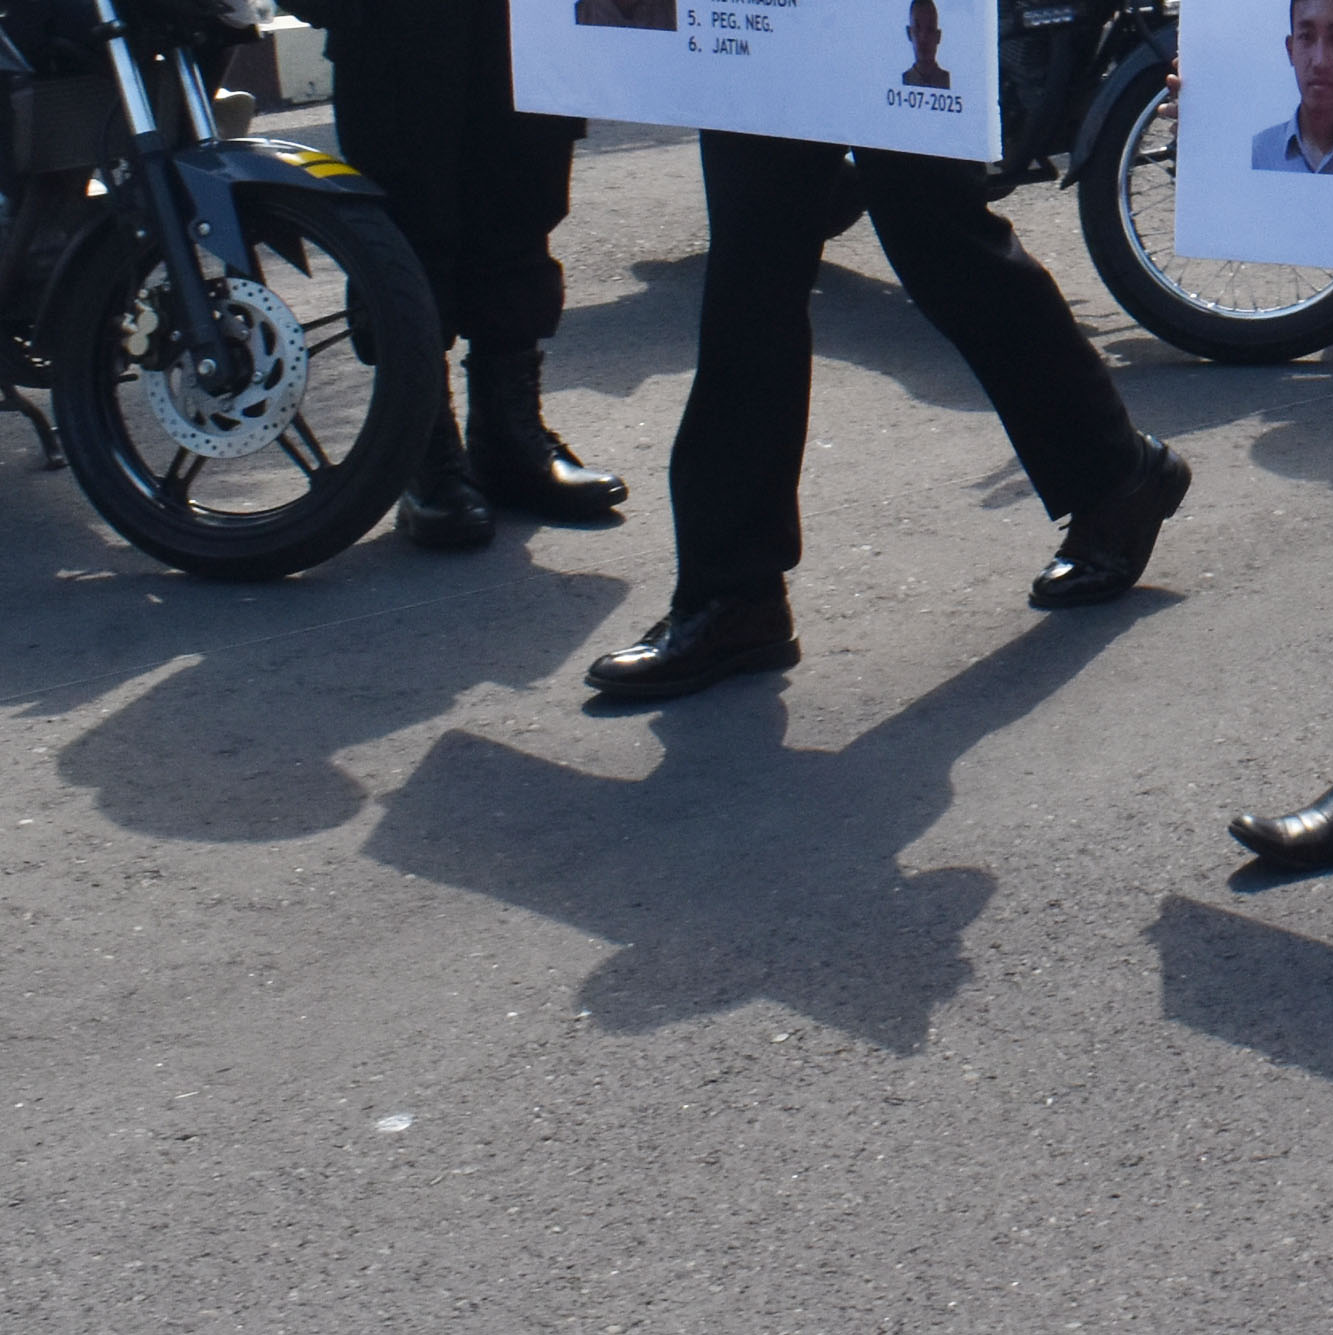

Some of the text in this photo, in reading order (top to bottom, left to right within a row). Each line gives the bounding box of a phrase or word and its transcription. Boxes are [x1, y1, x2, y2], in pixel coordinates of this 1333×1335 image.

[712, 12, 773, 32] PEG. NEG.
[713, 38, 750, 56] JATIM
[887, 90, 962, 113] 01-07-2025
